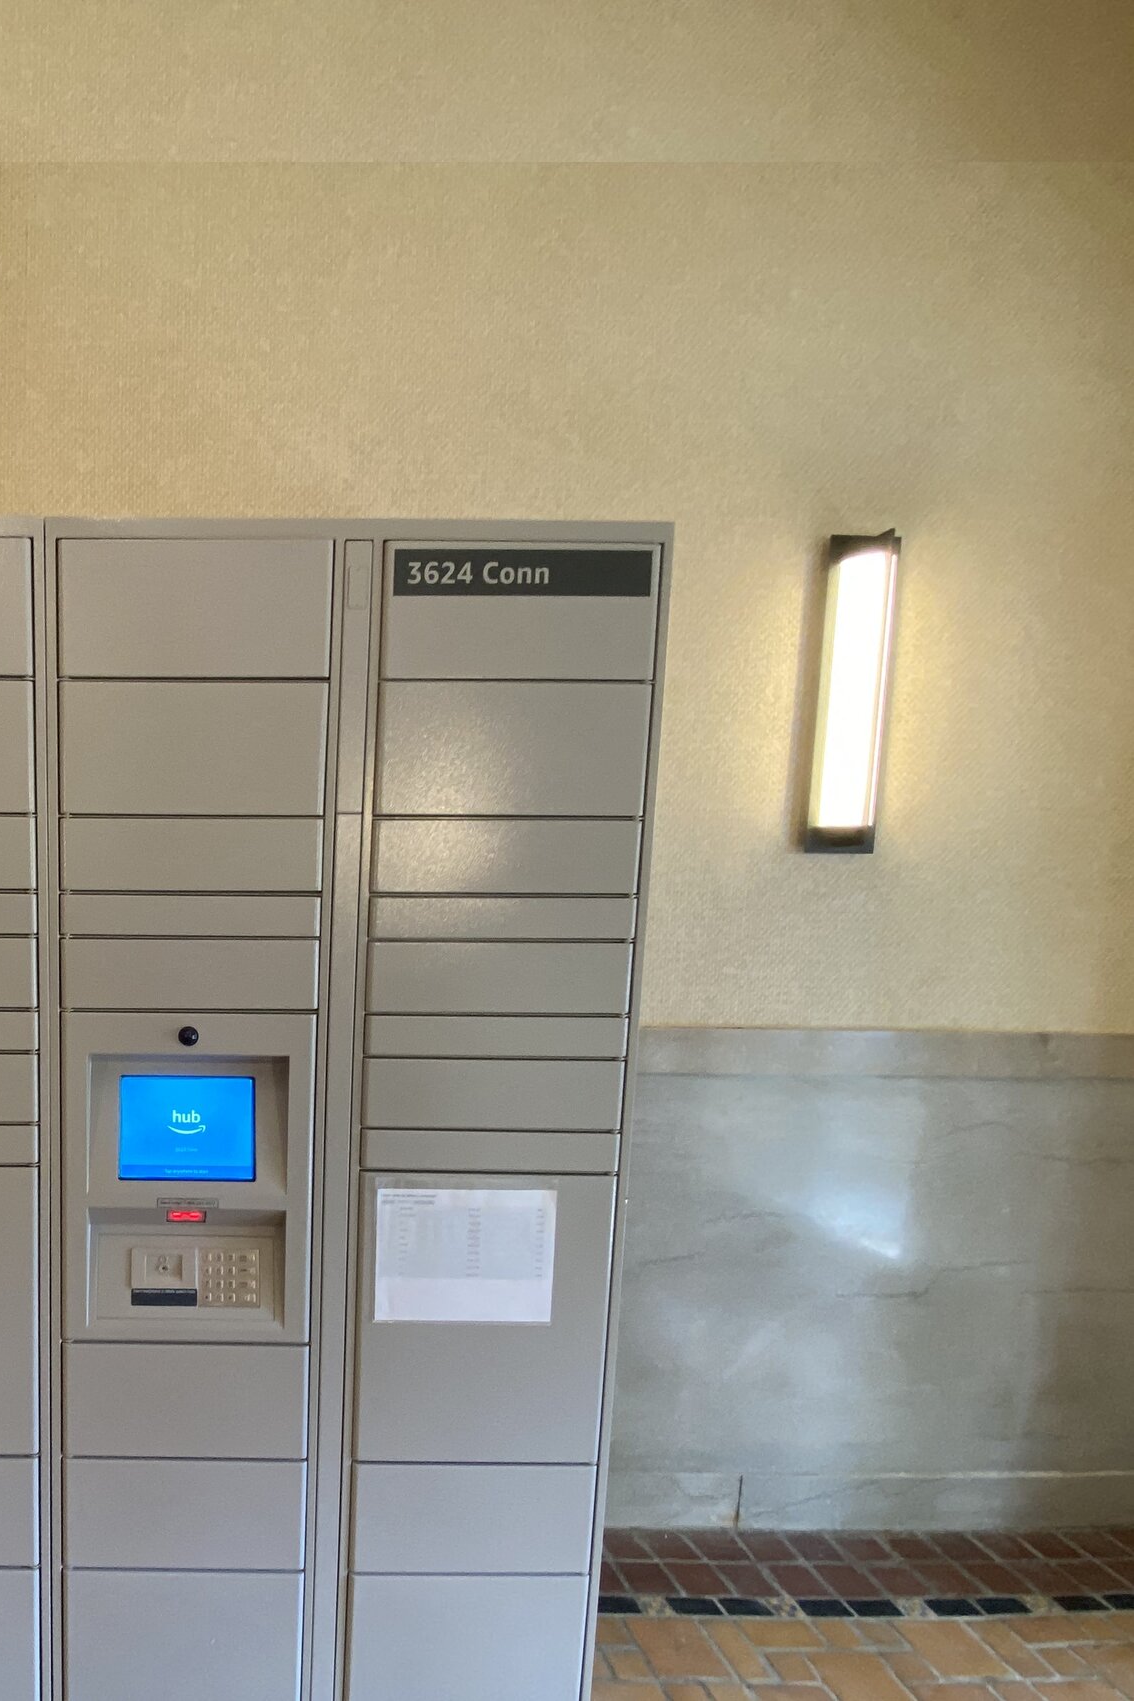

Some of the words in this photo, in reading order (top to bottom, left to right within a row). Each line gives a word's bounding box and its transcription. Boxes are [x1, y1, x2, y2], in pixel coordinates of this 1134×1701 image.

[407, 561, 473, 584] 3624
[482, 561, 550, 584] Conn
[172, 1109, 201, 1123] hub
